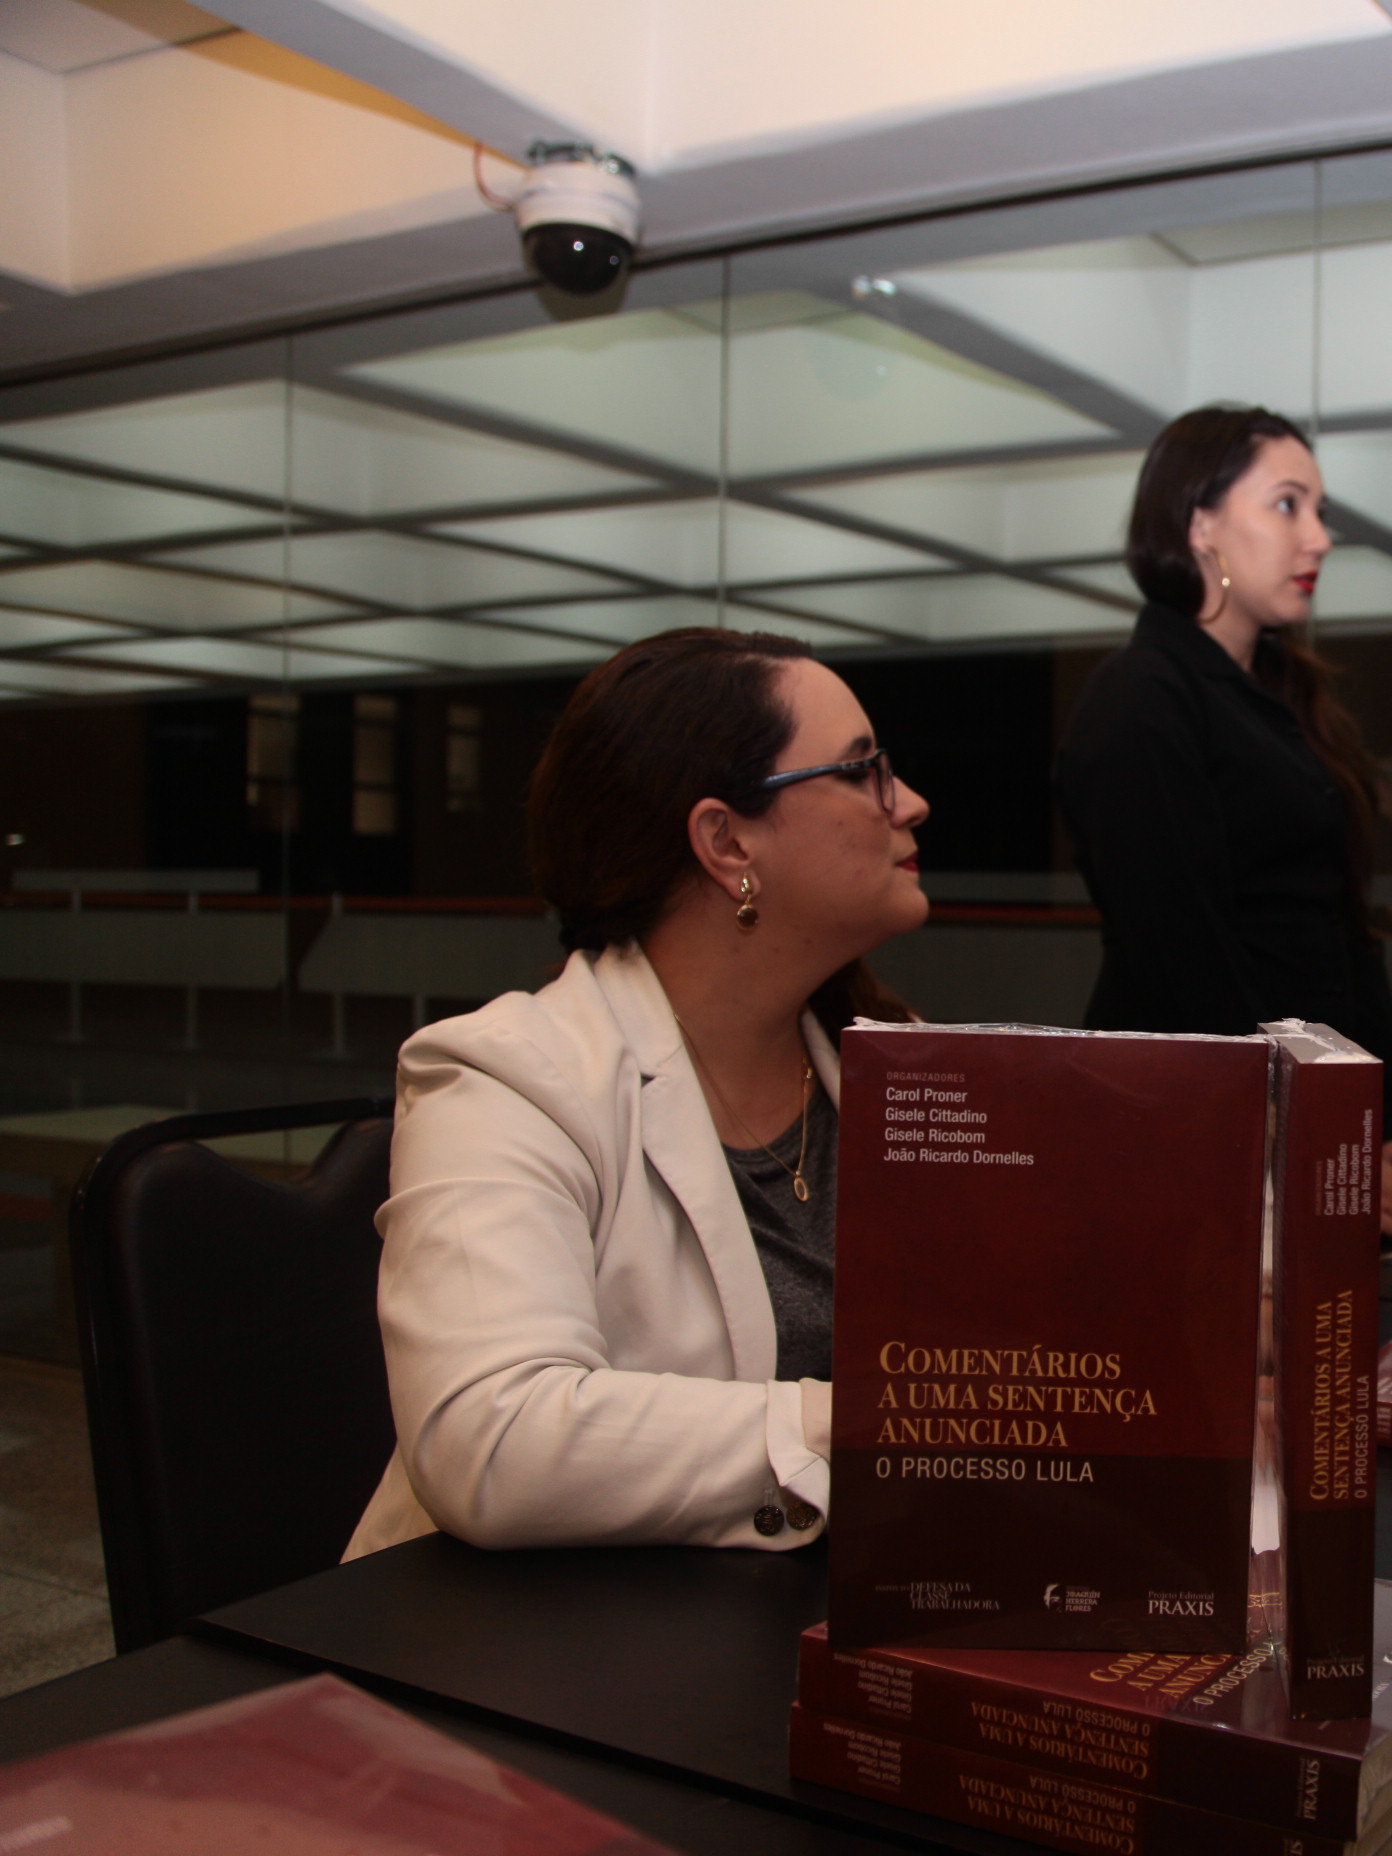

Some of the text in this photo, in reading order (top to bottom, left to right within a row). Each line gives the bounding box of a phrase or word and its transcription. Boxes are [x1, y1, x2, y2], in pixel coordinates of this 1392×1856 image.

[886, 1071, 966, 1083] ORGANIZADORES
[886, 1087, 968, 1102] Carol Proner
[884, 1127, 986, 1143] Gisele Ricobom
[885, 1107, 987, 1123] Gisele Cittadino
[1362, 1108, 1373, 1153] Dornelles
[884, 1147, 1034, 1165] João Ricardo Dornelles
[1361, 1154, 1372, 1190] Ricardo
[1324, 1158, 1335, 1216] Carol Proner
[1336, 1143, 1347, 1216] Gisele Cittadino
[1348, 1144, 1360, 1216] Gisele Ricobom
[879, 1341, 1122, 1380] COMENTÁRIOS
[877, 1382, 1158, 1423] A UMA SENTENÇA
[1309, 1301, 1333, 1501] COMENTÁRIOS A UMA
[1333, 1289, 1354, 1500] SENTENÇA ANUNCIADA
[876, 1417, 1069, 1448] ANUNCIADA
[1354, 1375, 1370, 1499] O PROCESSO LULA
[875, 1456, 1094, 1483] O PROCESSO LULA
[1148, 1590, 1214, 1601] Projeto Editorial
[1148, 1600, 1214, 1616] PRAXIS
[1127, 1672, 1153, 1691] A
[1158, 1654, 1232, 1698] ANUNC
[1193, 1647, 1272, 1705] O PROCESSO
[1307, 1663, 1365, 1680] PRAXIS
[971, 1701, 1150, 1758] SENTENÇA ANUNCIADA
[1042, 1700, 1151, 1737] O PROCESSO LULA
[979, 1722, 1148, 1780] COMENTÁRIOS A UMA
[959, 1775, 1136, 1833] SENTENÇA ANUNCIADA
[1030, 1776, 1137, 1814] O PROCESSO LULA
[1303, 1759, 1320, 1820] PRAXIS
[967, 1796, 1135, 1855] COMENTÁRIOS A UMA
